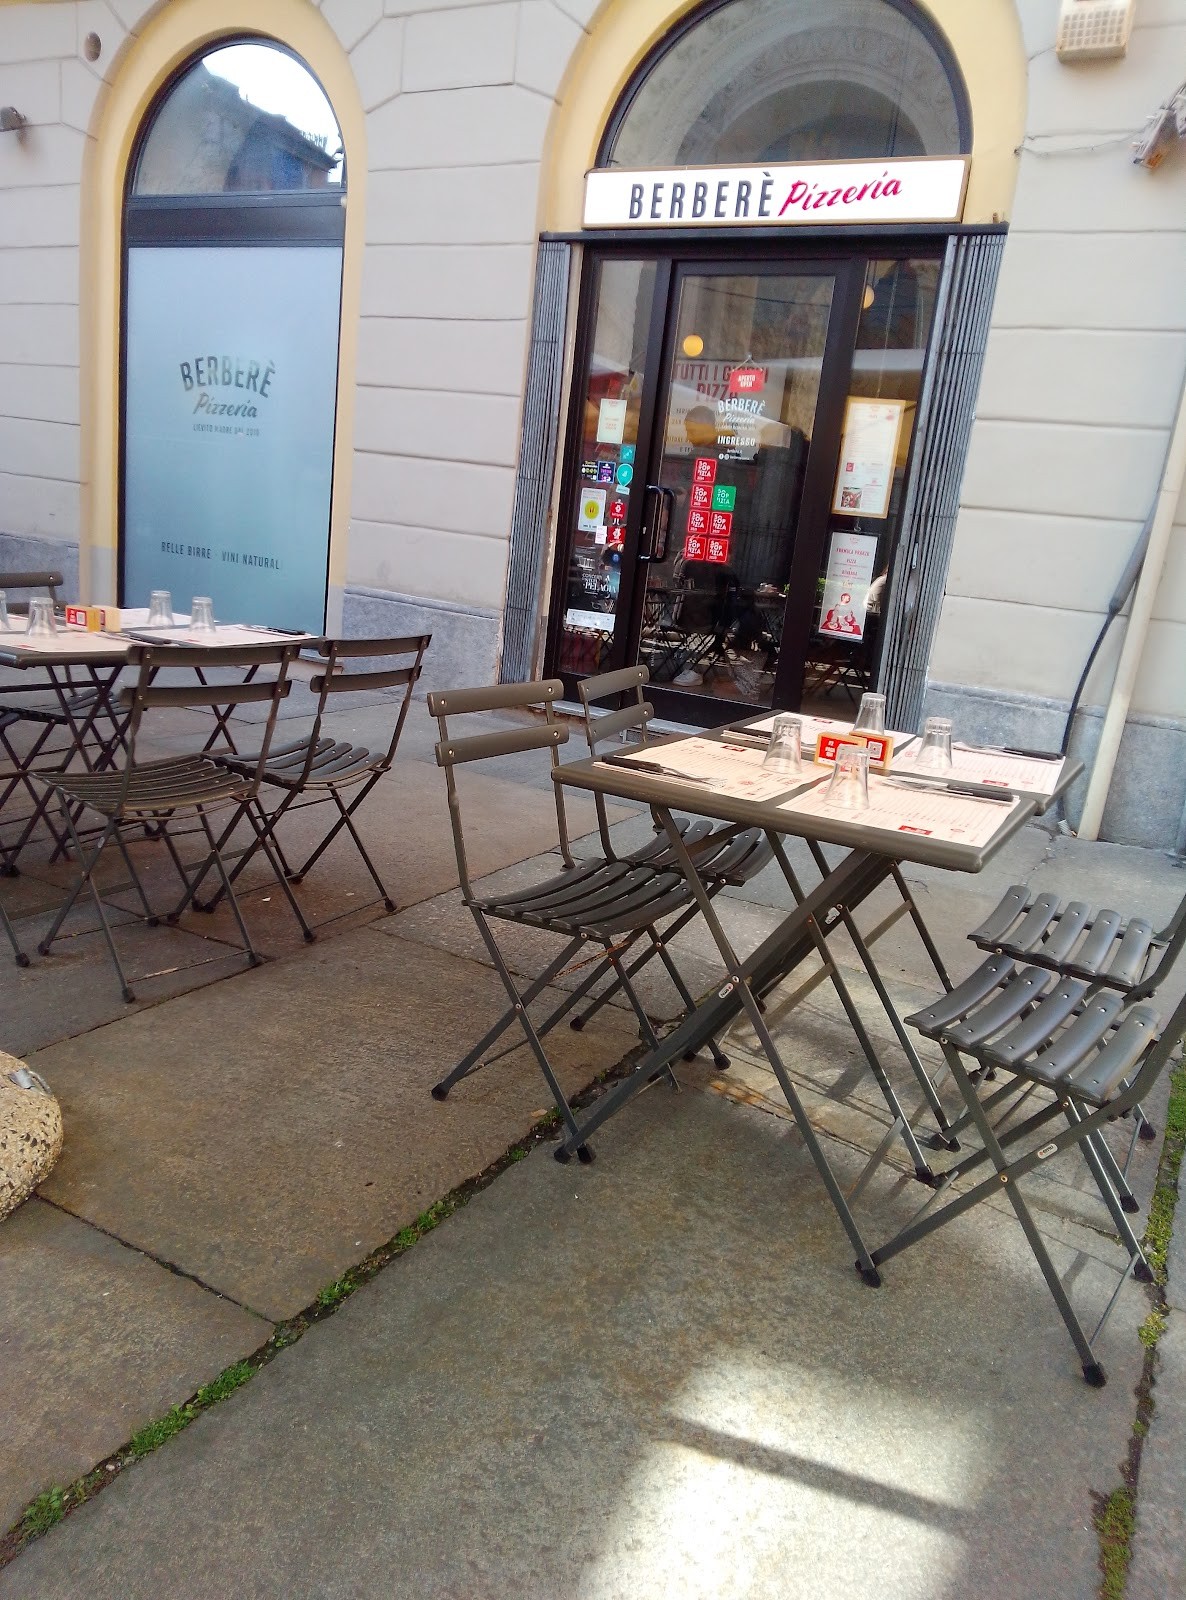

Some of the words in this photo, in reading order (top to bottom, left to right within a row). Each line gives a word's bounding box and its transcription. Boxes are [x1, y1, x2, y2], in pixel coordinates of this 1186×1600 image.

[629, 171, 774, 219] BERBERÈ
[778, 170, 903, 217] Pizzeria
[180, 355, 275, 398] BERBERÈ
[193, 392, 258, 418] Pizzeria
[718, 398, 766, 416] BERBERÈ
[717, 435, 756, 447] INGRESSO
[161, 541, 184, 555] BELLE
[187, 545, 211, 559] BIRRE
[222, 551, 239, 564] VINI
